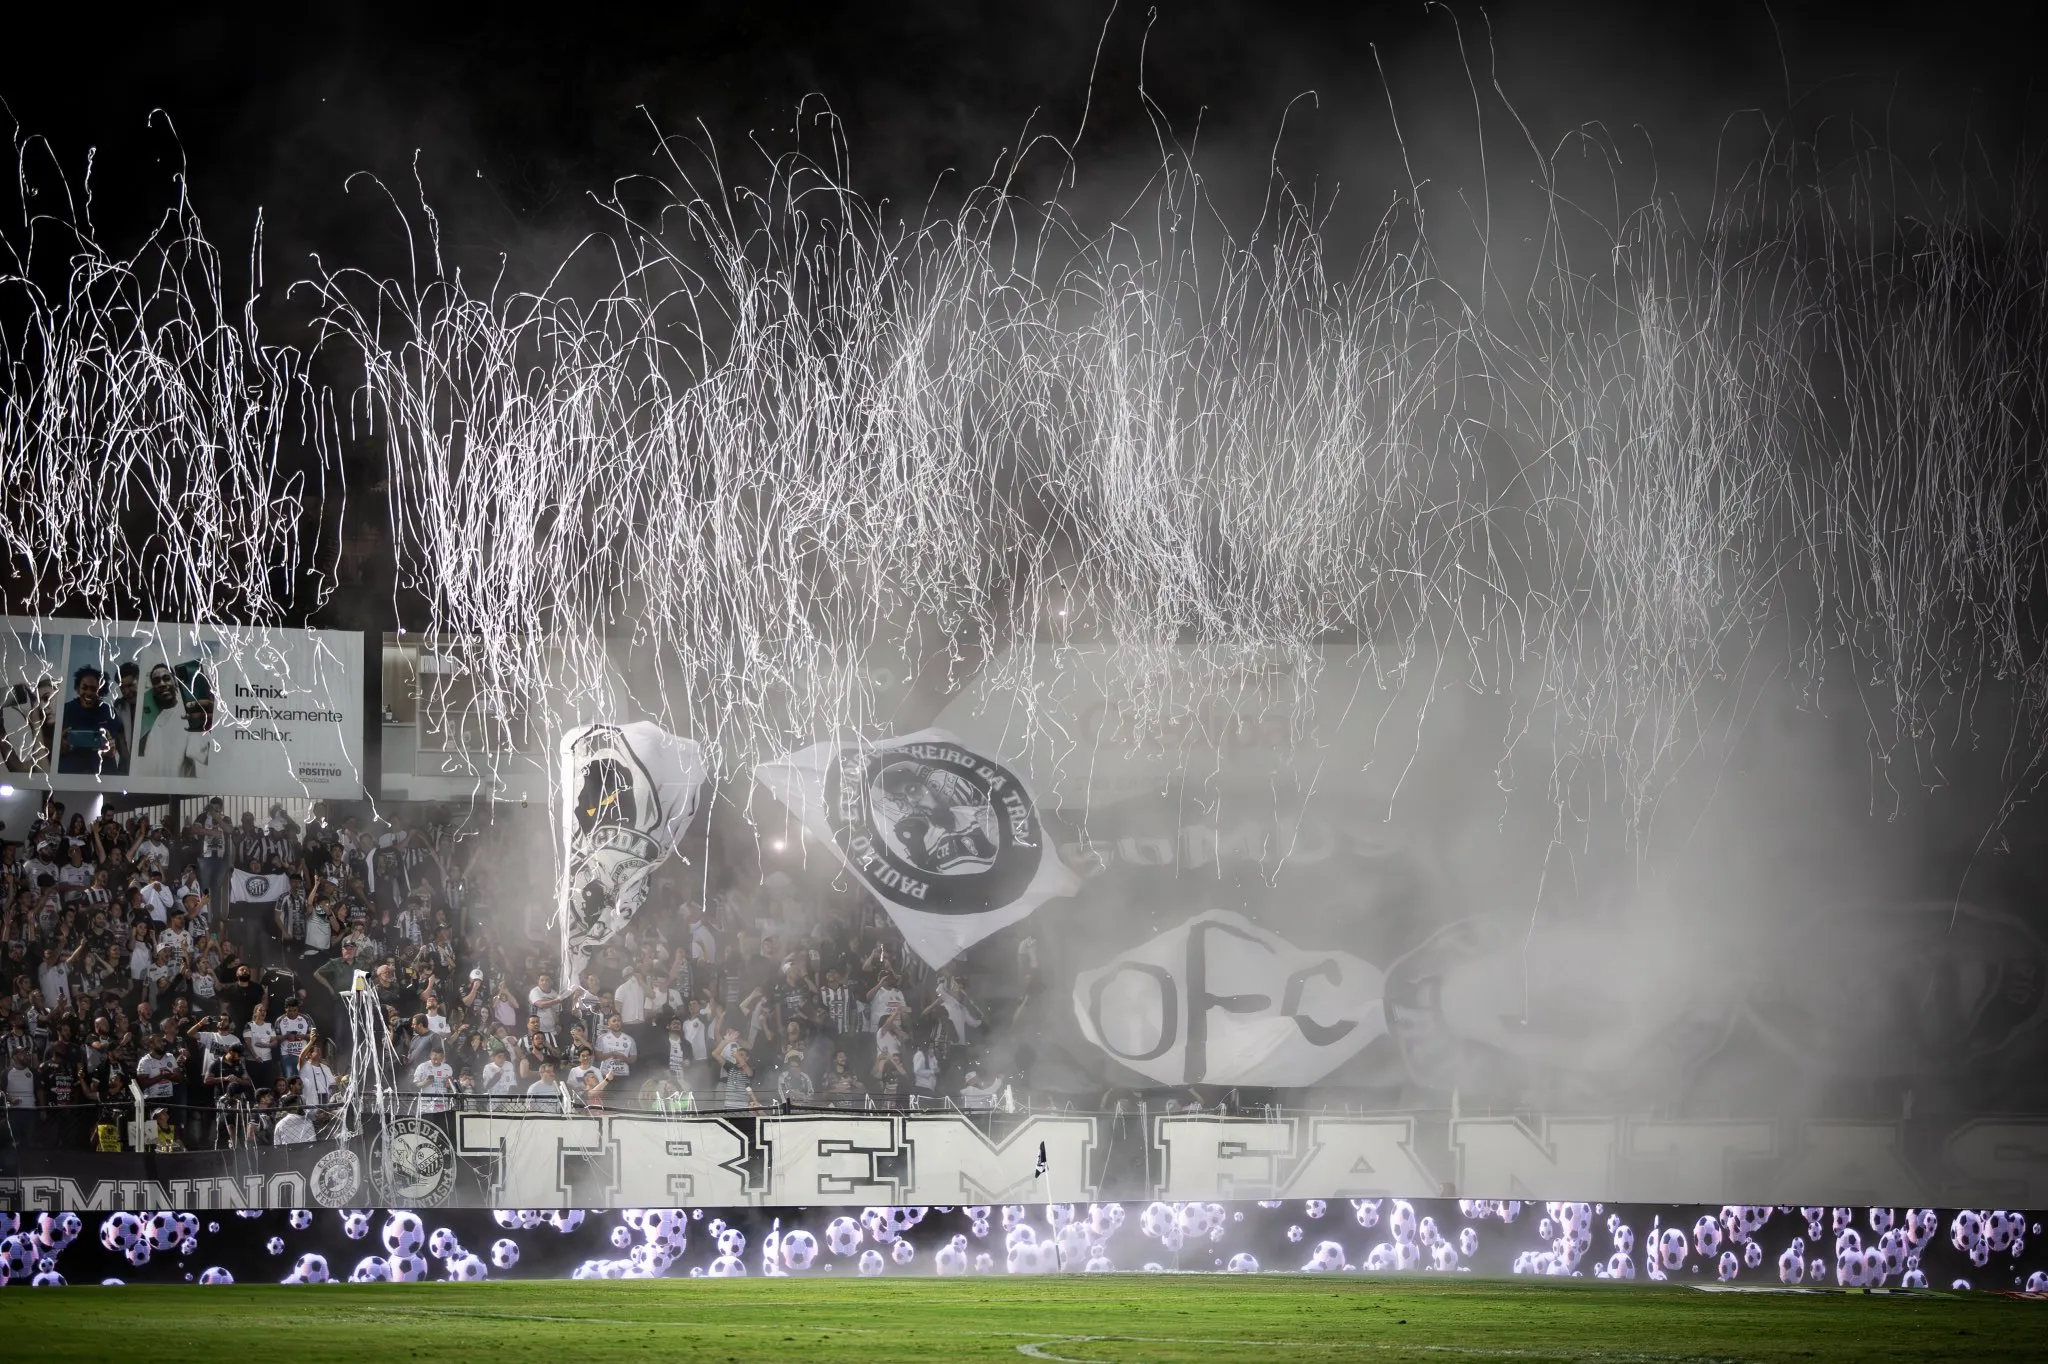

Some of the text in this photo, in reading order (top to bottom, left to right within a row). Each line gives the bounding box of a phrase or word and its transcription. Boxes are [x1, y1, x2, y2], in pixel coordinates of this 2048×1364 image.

[235, 684, 288, 699] Infinix.
[235, 705, 344, 723] Infinixamente
[235, 728, 293, 742] melhor.
[299, 768, 342, 777] POSITIVO
[384, 1121, 440, 1143] ORCIDA
[457, 1111, 1099, 1207] TREM
[404, 1168, 453, 1208] NTASMA
